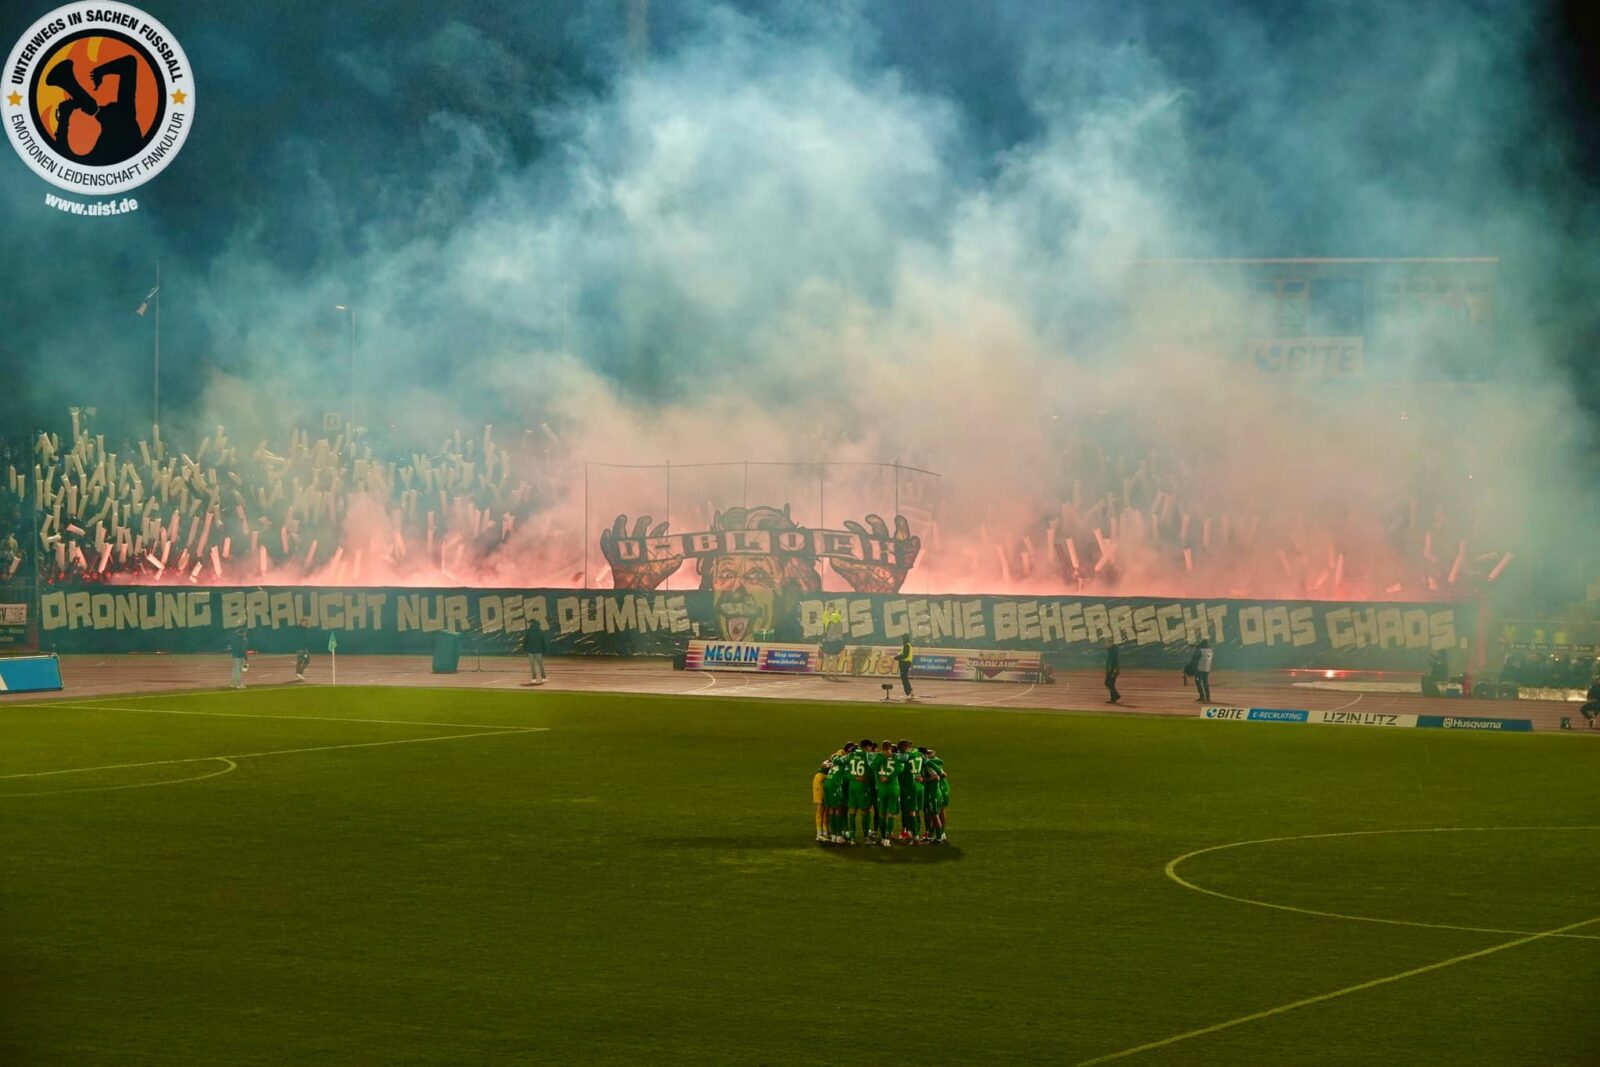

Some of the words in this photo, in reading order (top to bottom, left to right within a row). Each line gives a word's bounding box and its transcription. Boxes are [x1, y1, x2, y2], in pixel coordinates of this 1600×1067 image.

[41, 591, 211, 630] ORDNUNG
[221, 591, 386, 631] BRAUCHT
[397, 594, 471, 634] NUR
[479, 594, 550, 634] DER
[800, 598, 874, 639] DAS
[883, 599, 986, 640] GENIE
[993, 601, 1228, 646] BEHERRSCHT
[1239, 606, 1316, 648] DAS
[1324, 607, 1469, 650] CHAOS.
[1217, 709, 1244, 720] BITE
[1252, 710, 1303, 721] E-RECRUITING
[1322, 711, 1362, 724] UZIN
[1363, 713, 1399, 726] UTZ
[1453, 719, 1502, 730] Husqvarna
[850, 759, 865, 776] 16
[908, 757, 923, 774] 17
